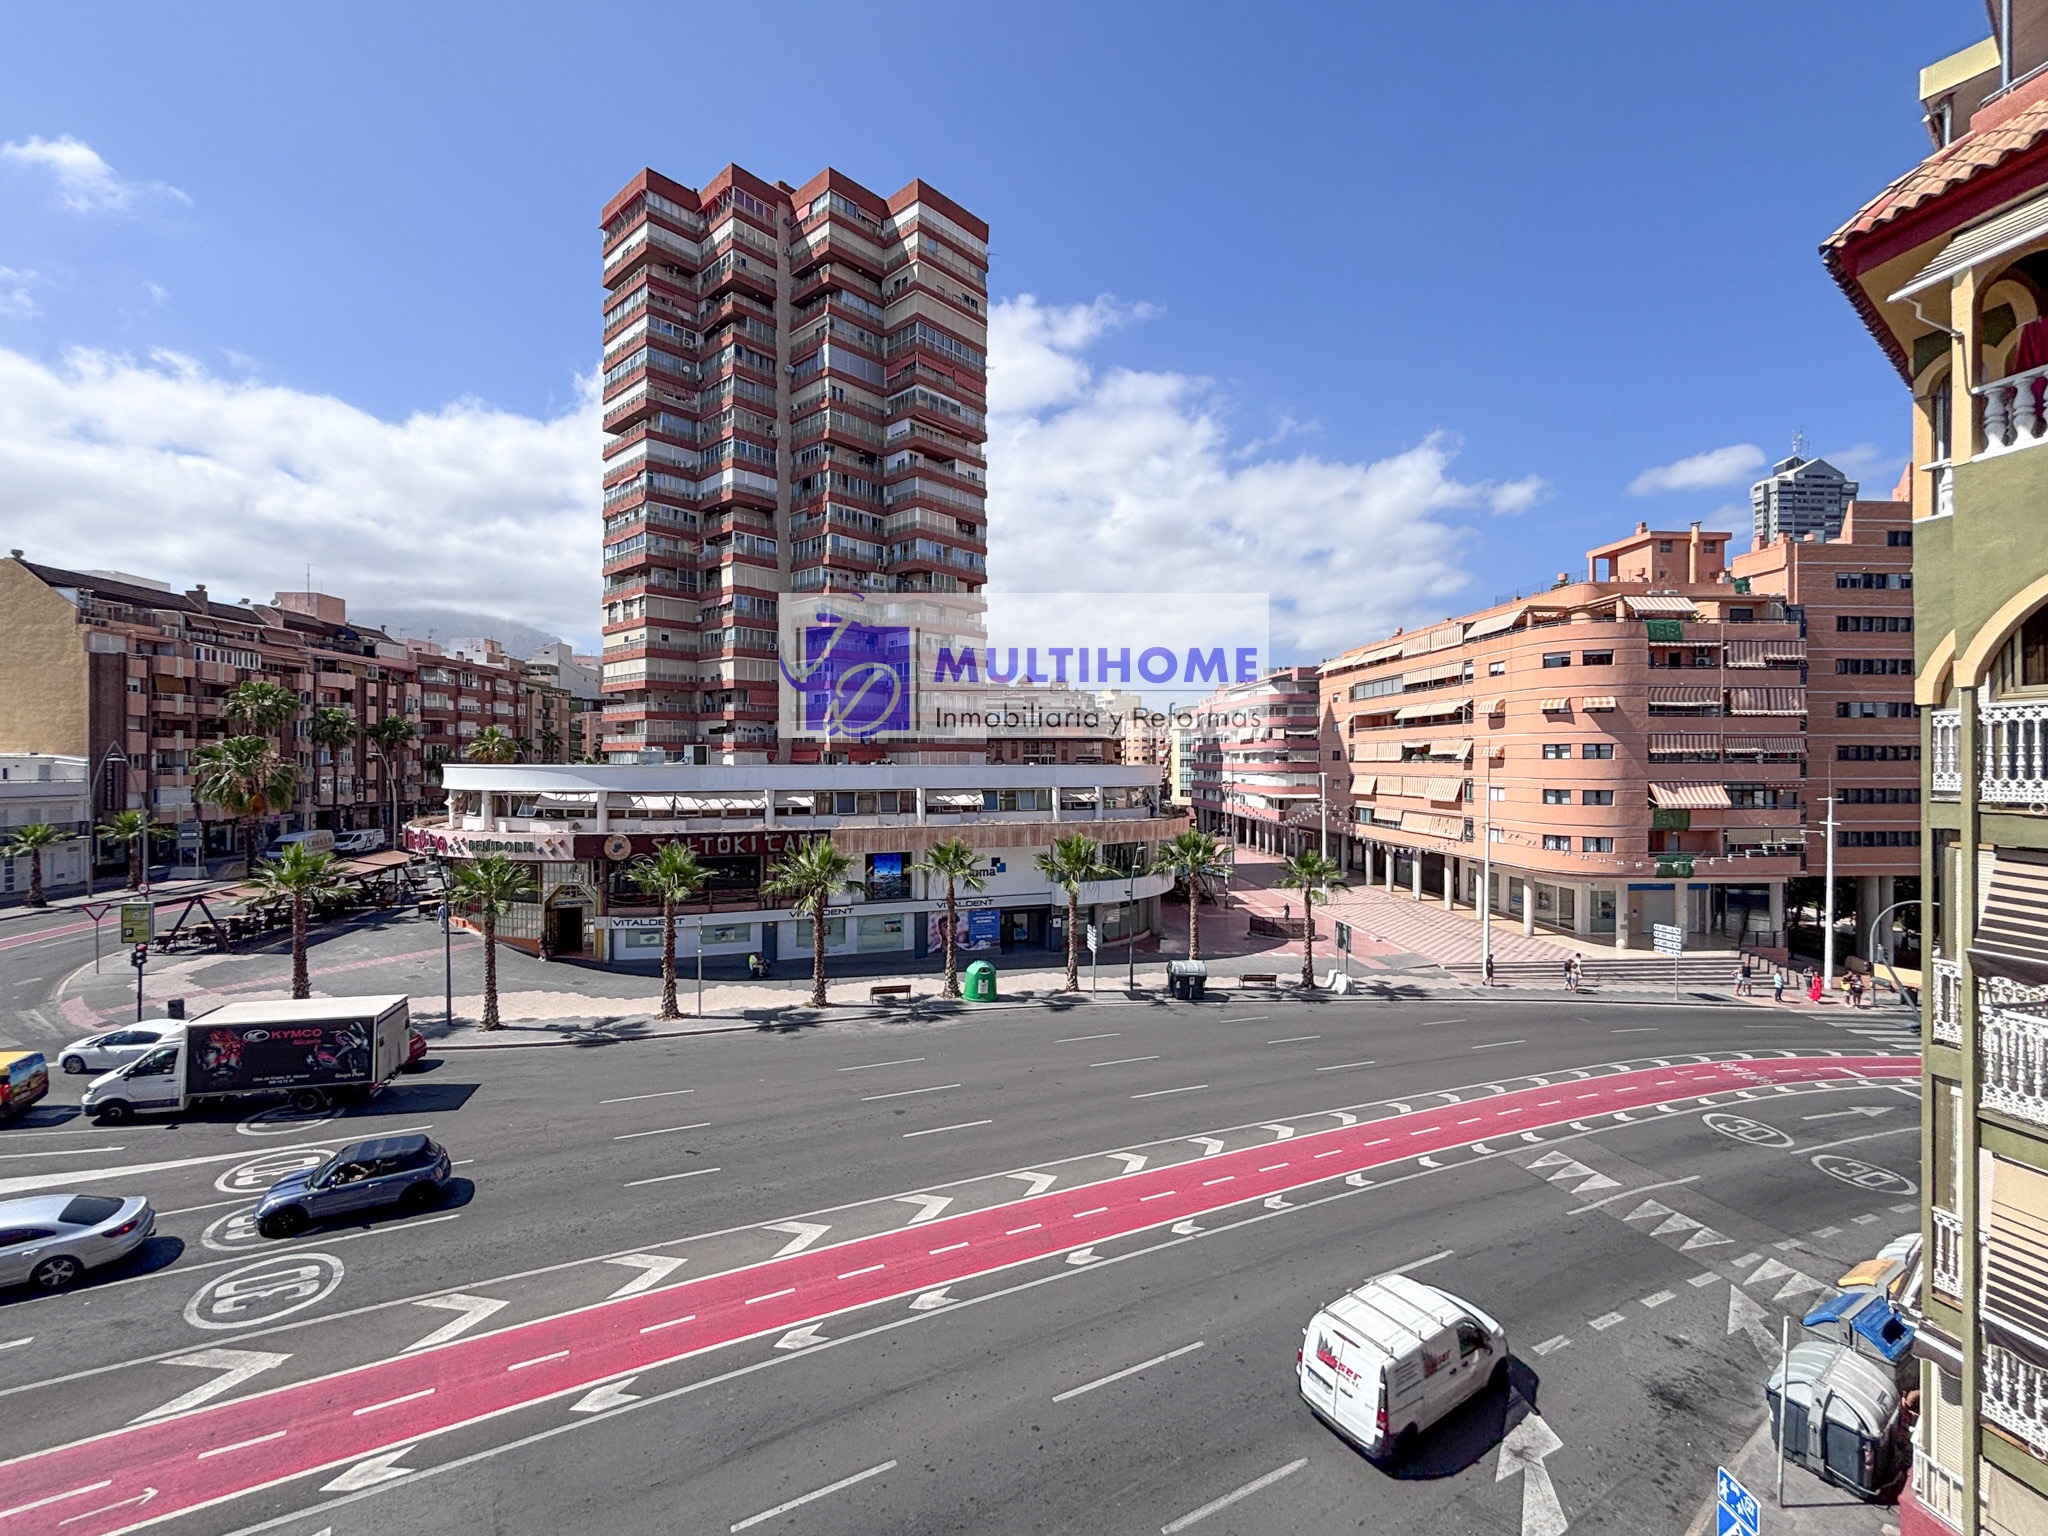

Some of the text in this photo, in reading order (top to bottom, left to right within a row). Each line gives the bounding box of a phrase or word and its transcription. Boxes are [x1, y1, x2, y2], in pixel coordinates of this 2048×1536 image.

[468, 839, 534, 853] BENIDORM
[936, 899, 994, 908] VIALDENT
[789, 907, 855, 918] VITADENT
[612, 917, 685, 927] VITALDET
[271, 1028, 323, 1040] KYMCO
[1716, 1119, 1779, 1141] 30
[1829, 1161, 1899, 1187] 30
[212, 1264, 321, 1314] 30
